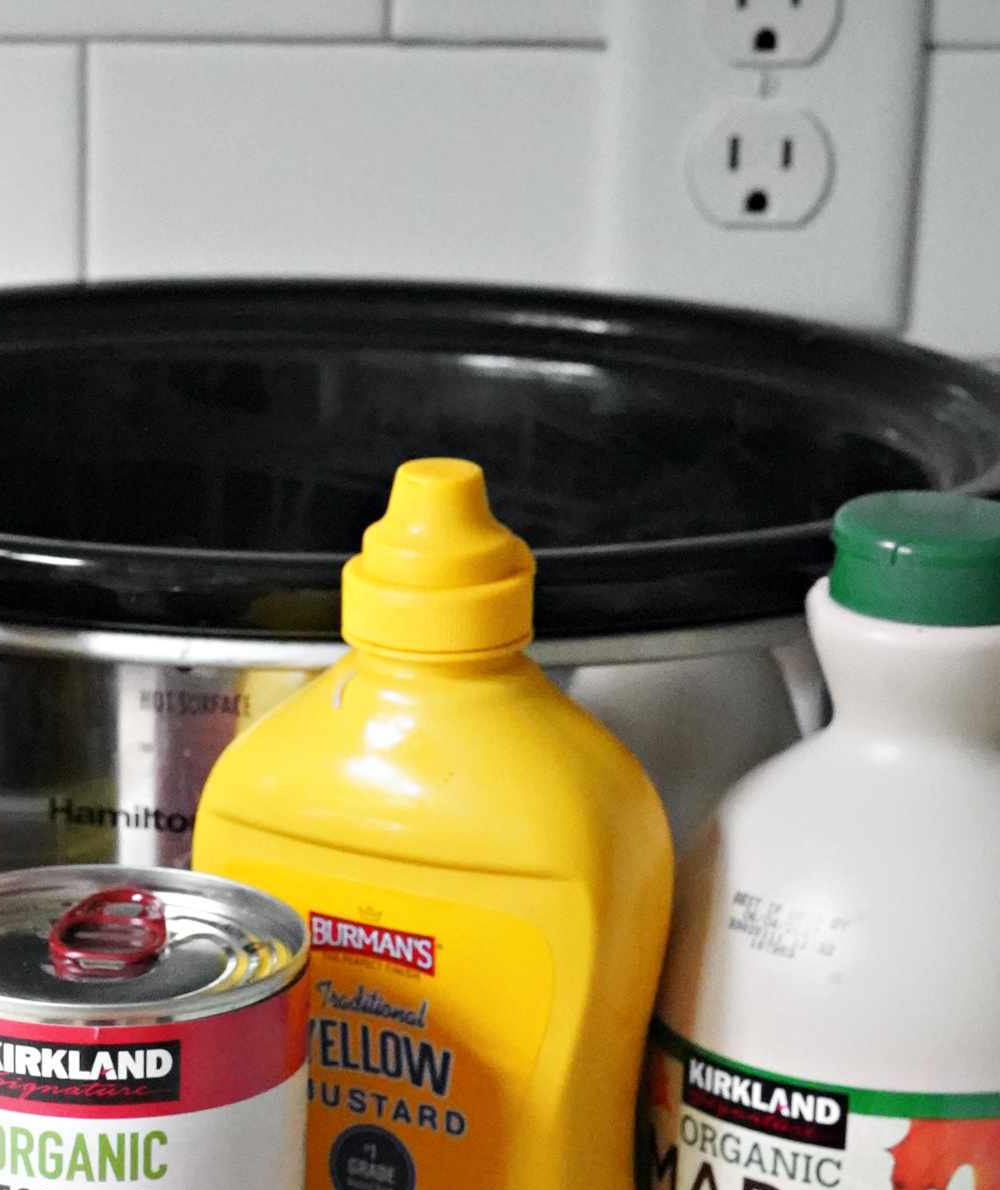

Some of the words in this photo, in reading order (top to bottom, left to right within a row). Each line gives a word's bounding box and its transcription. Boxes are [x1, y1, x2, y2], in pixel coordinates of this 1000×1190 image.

[311, 915, 434, 970] BURMAN'S
[314, 979, 428, 1030] Traditional
[308, 1076, 467, 1137] USTARD
[688, 1058, 842, 1127] KIRKLAND
[679, 1114, 843, 1188] ORGANIC
